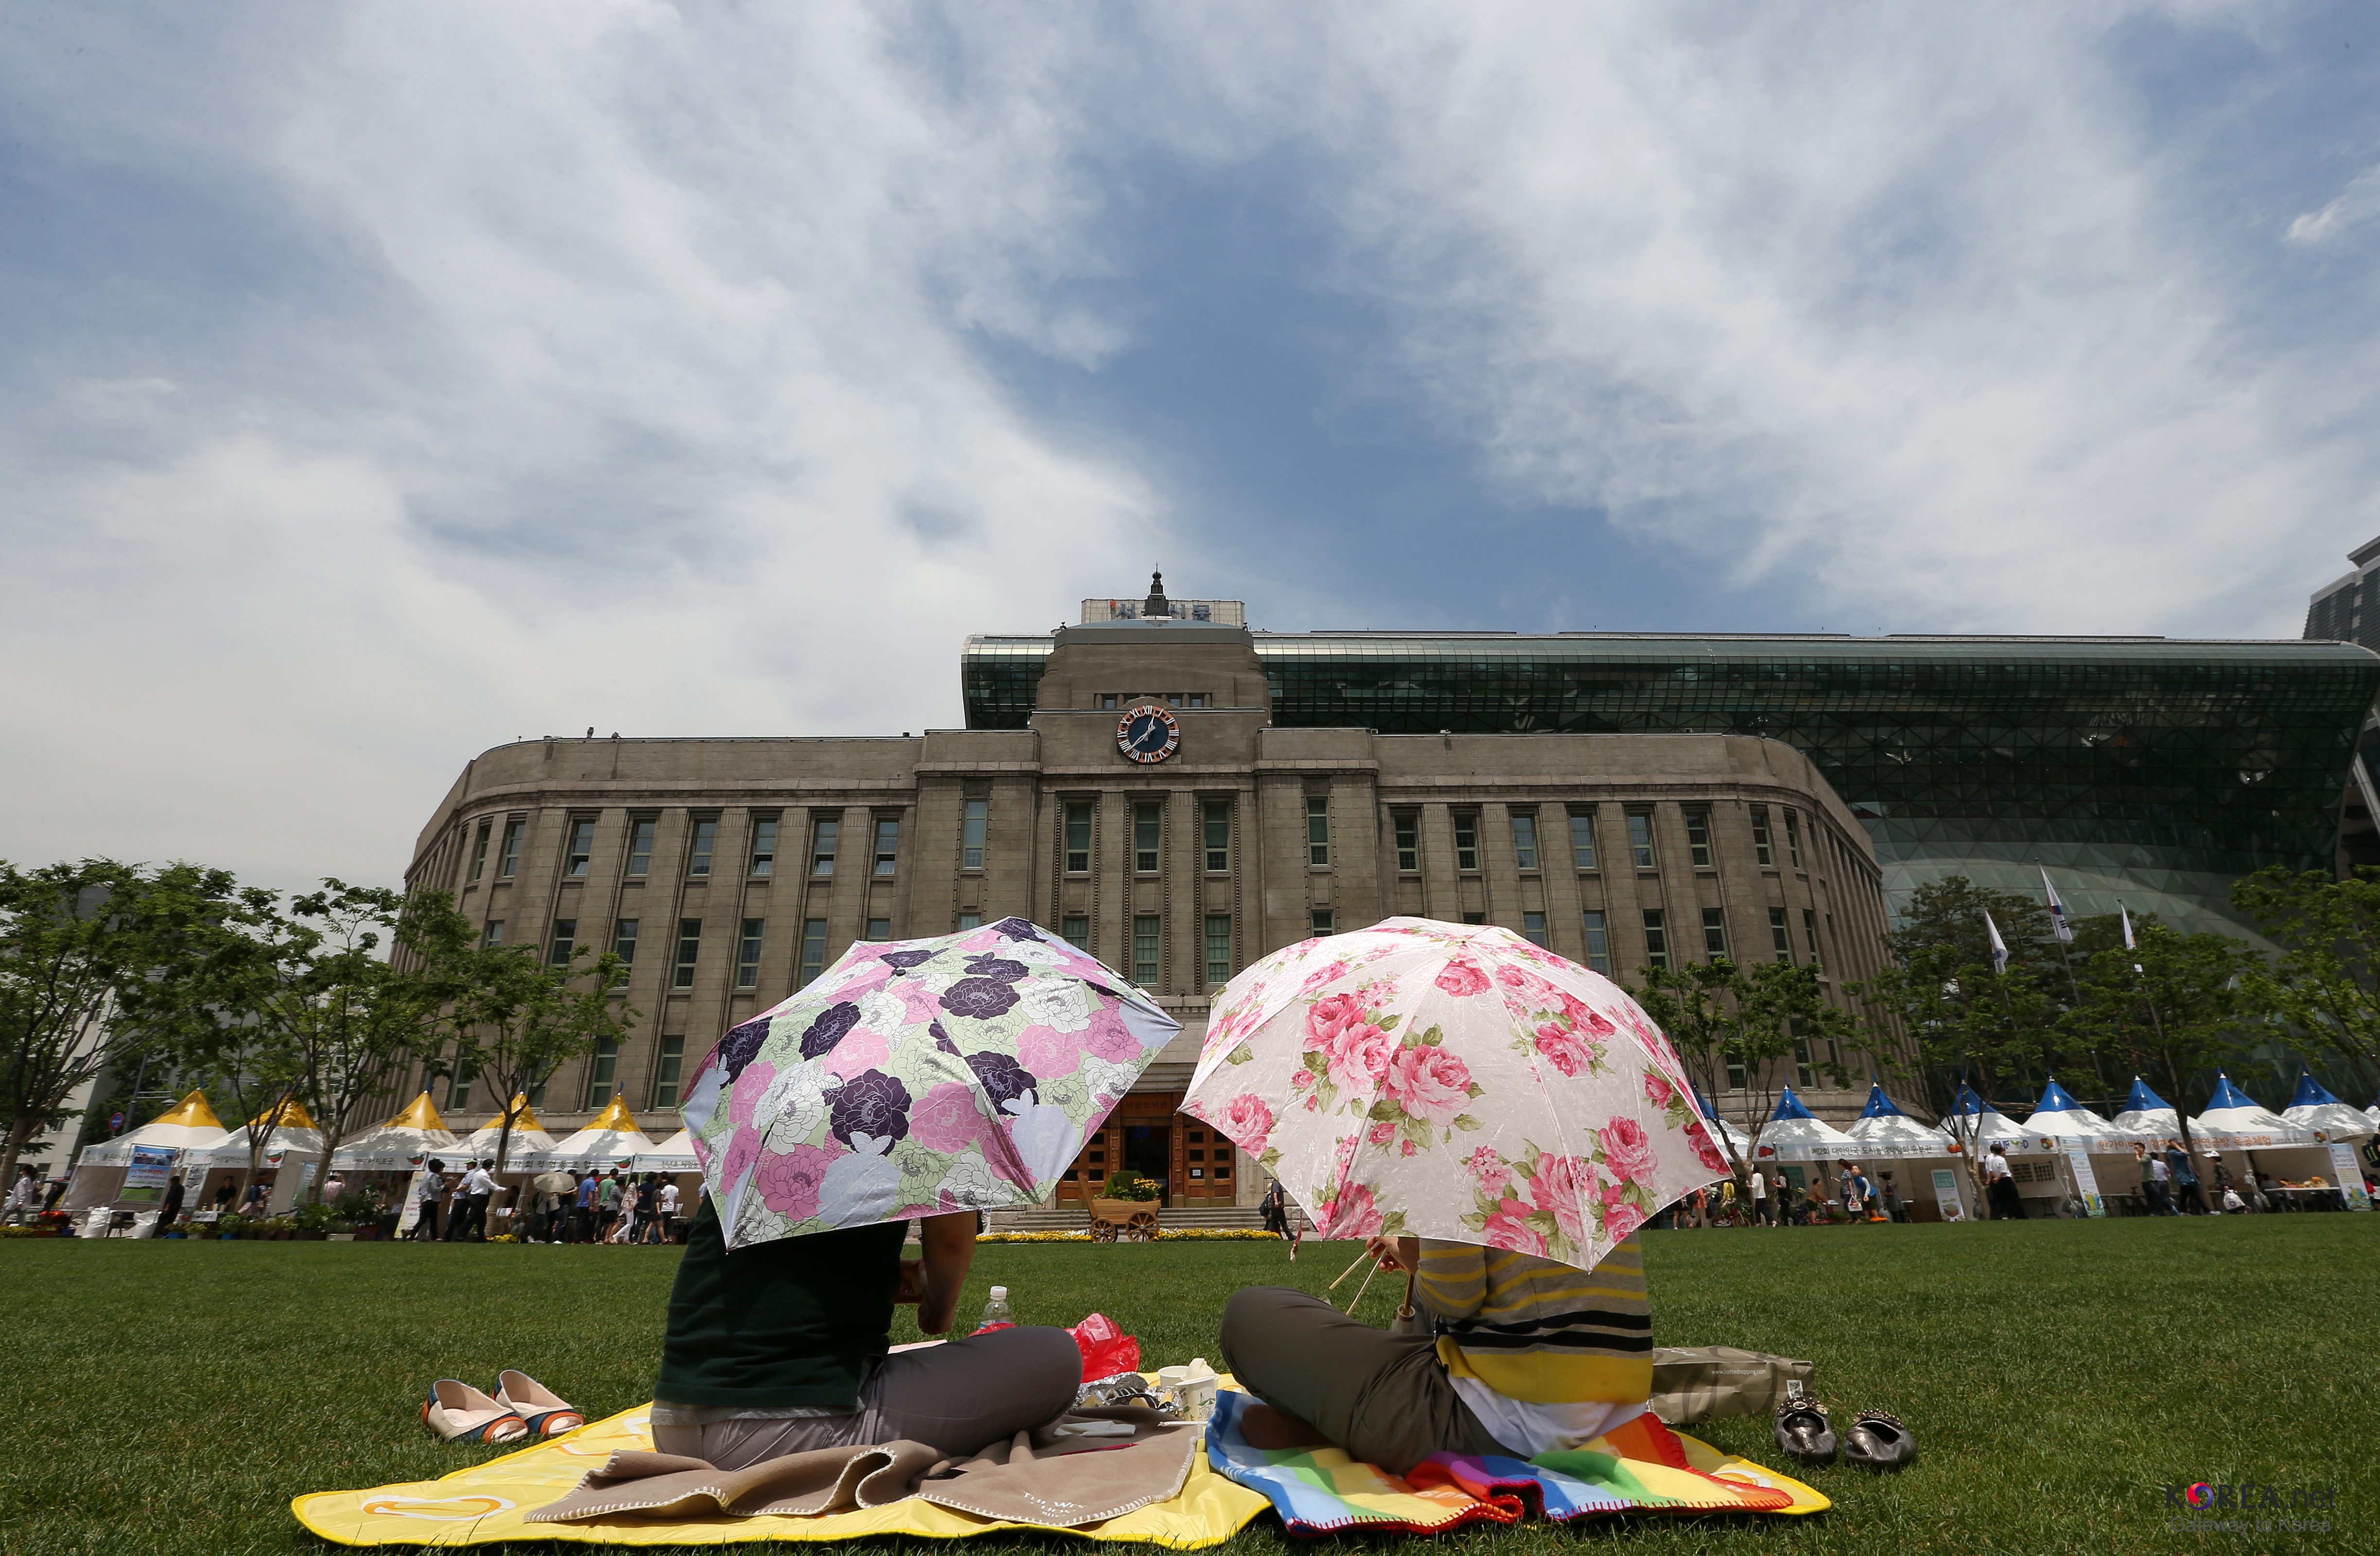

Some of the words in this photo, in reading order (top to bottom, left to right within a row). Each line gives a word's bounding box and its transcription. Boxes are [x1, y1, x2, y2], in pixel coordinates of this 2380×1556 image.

[1116, 603, 1211, 622] 서신문
[1129, 708, 1140, 718] XI
[1142, 705, 1153, 715] XII
[1158, 709, 1164, 717] I
[1120, 717, 1131, 726] X
[1144, 752, 1153, 762] VI
[1158, 750, 1167, 759] V
[1126, 1101, 1168, 1110] 서울도서관
[2234, 1135, 2272, 1147] 목공체험
[1812, 1148, 1830, 1156] 제2회
[1832, 1146, 1860, 1156] 대한민국
[1862, 1145, 1909, 1155] 도시농업박람회
[1911, 1145, 1933, 1154] 홍보관
